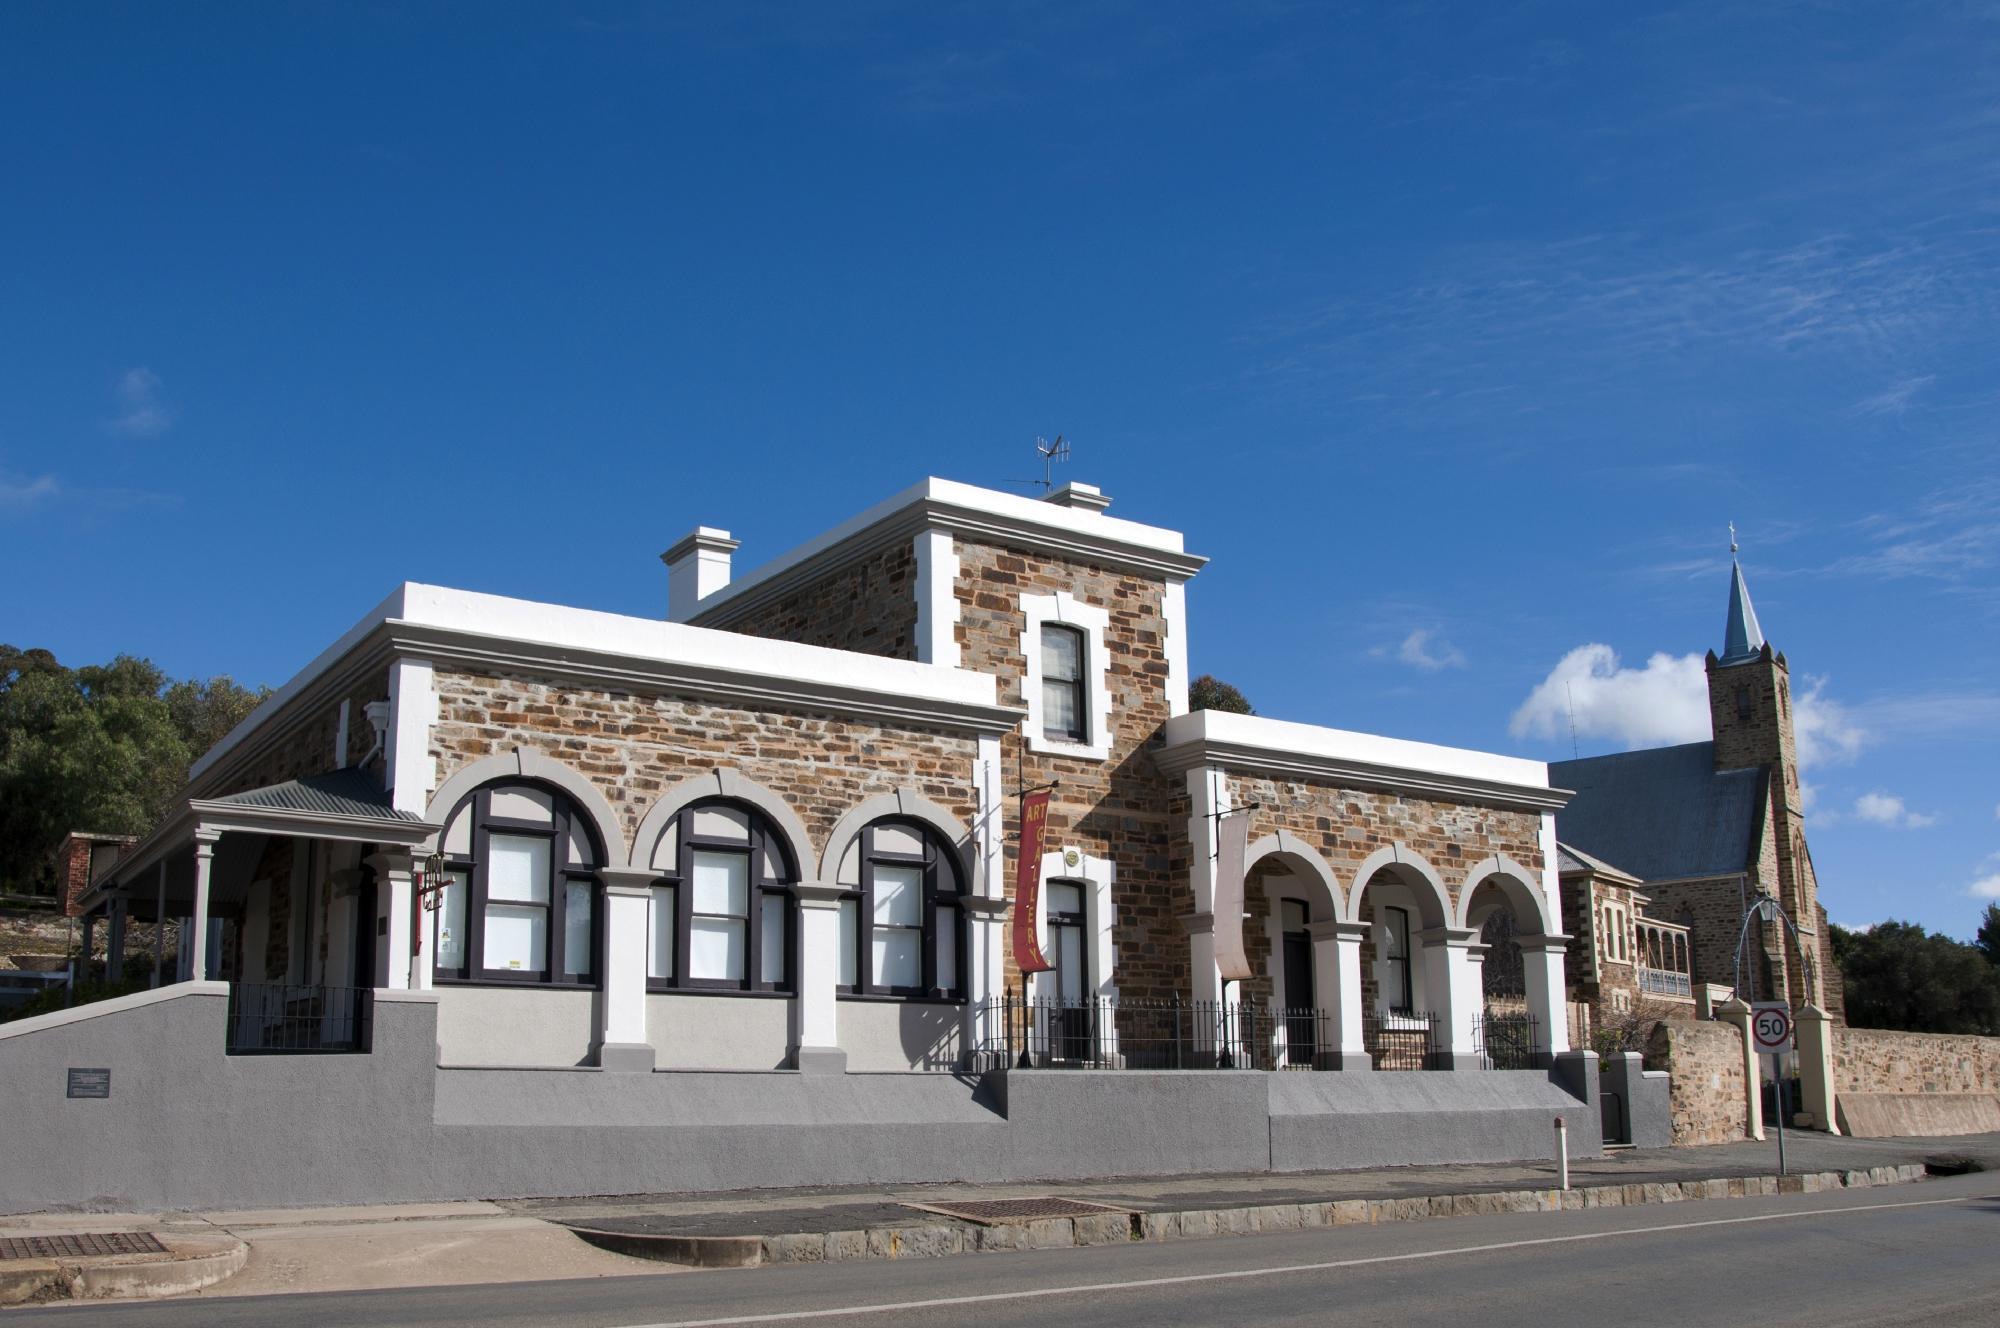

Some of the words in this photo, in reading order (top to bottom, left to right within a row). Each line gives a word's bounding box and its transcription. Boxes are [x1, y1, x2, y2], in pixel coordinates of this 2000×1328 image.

[1026, 802, 1047, 823] ART
[1026, 826, 1044, 963] GALLERY
[1759, 1019, 1784, 1036] 50
